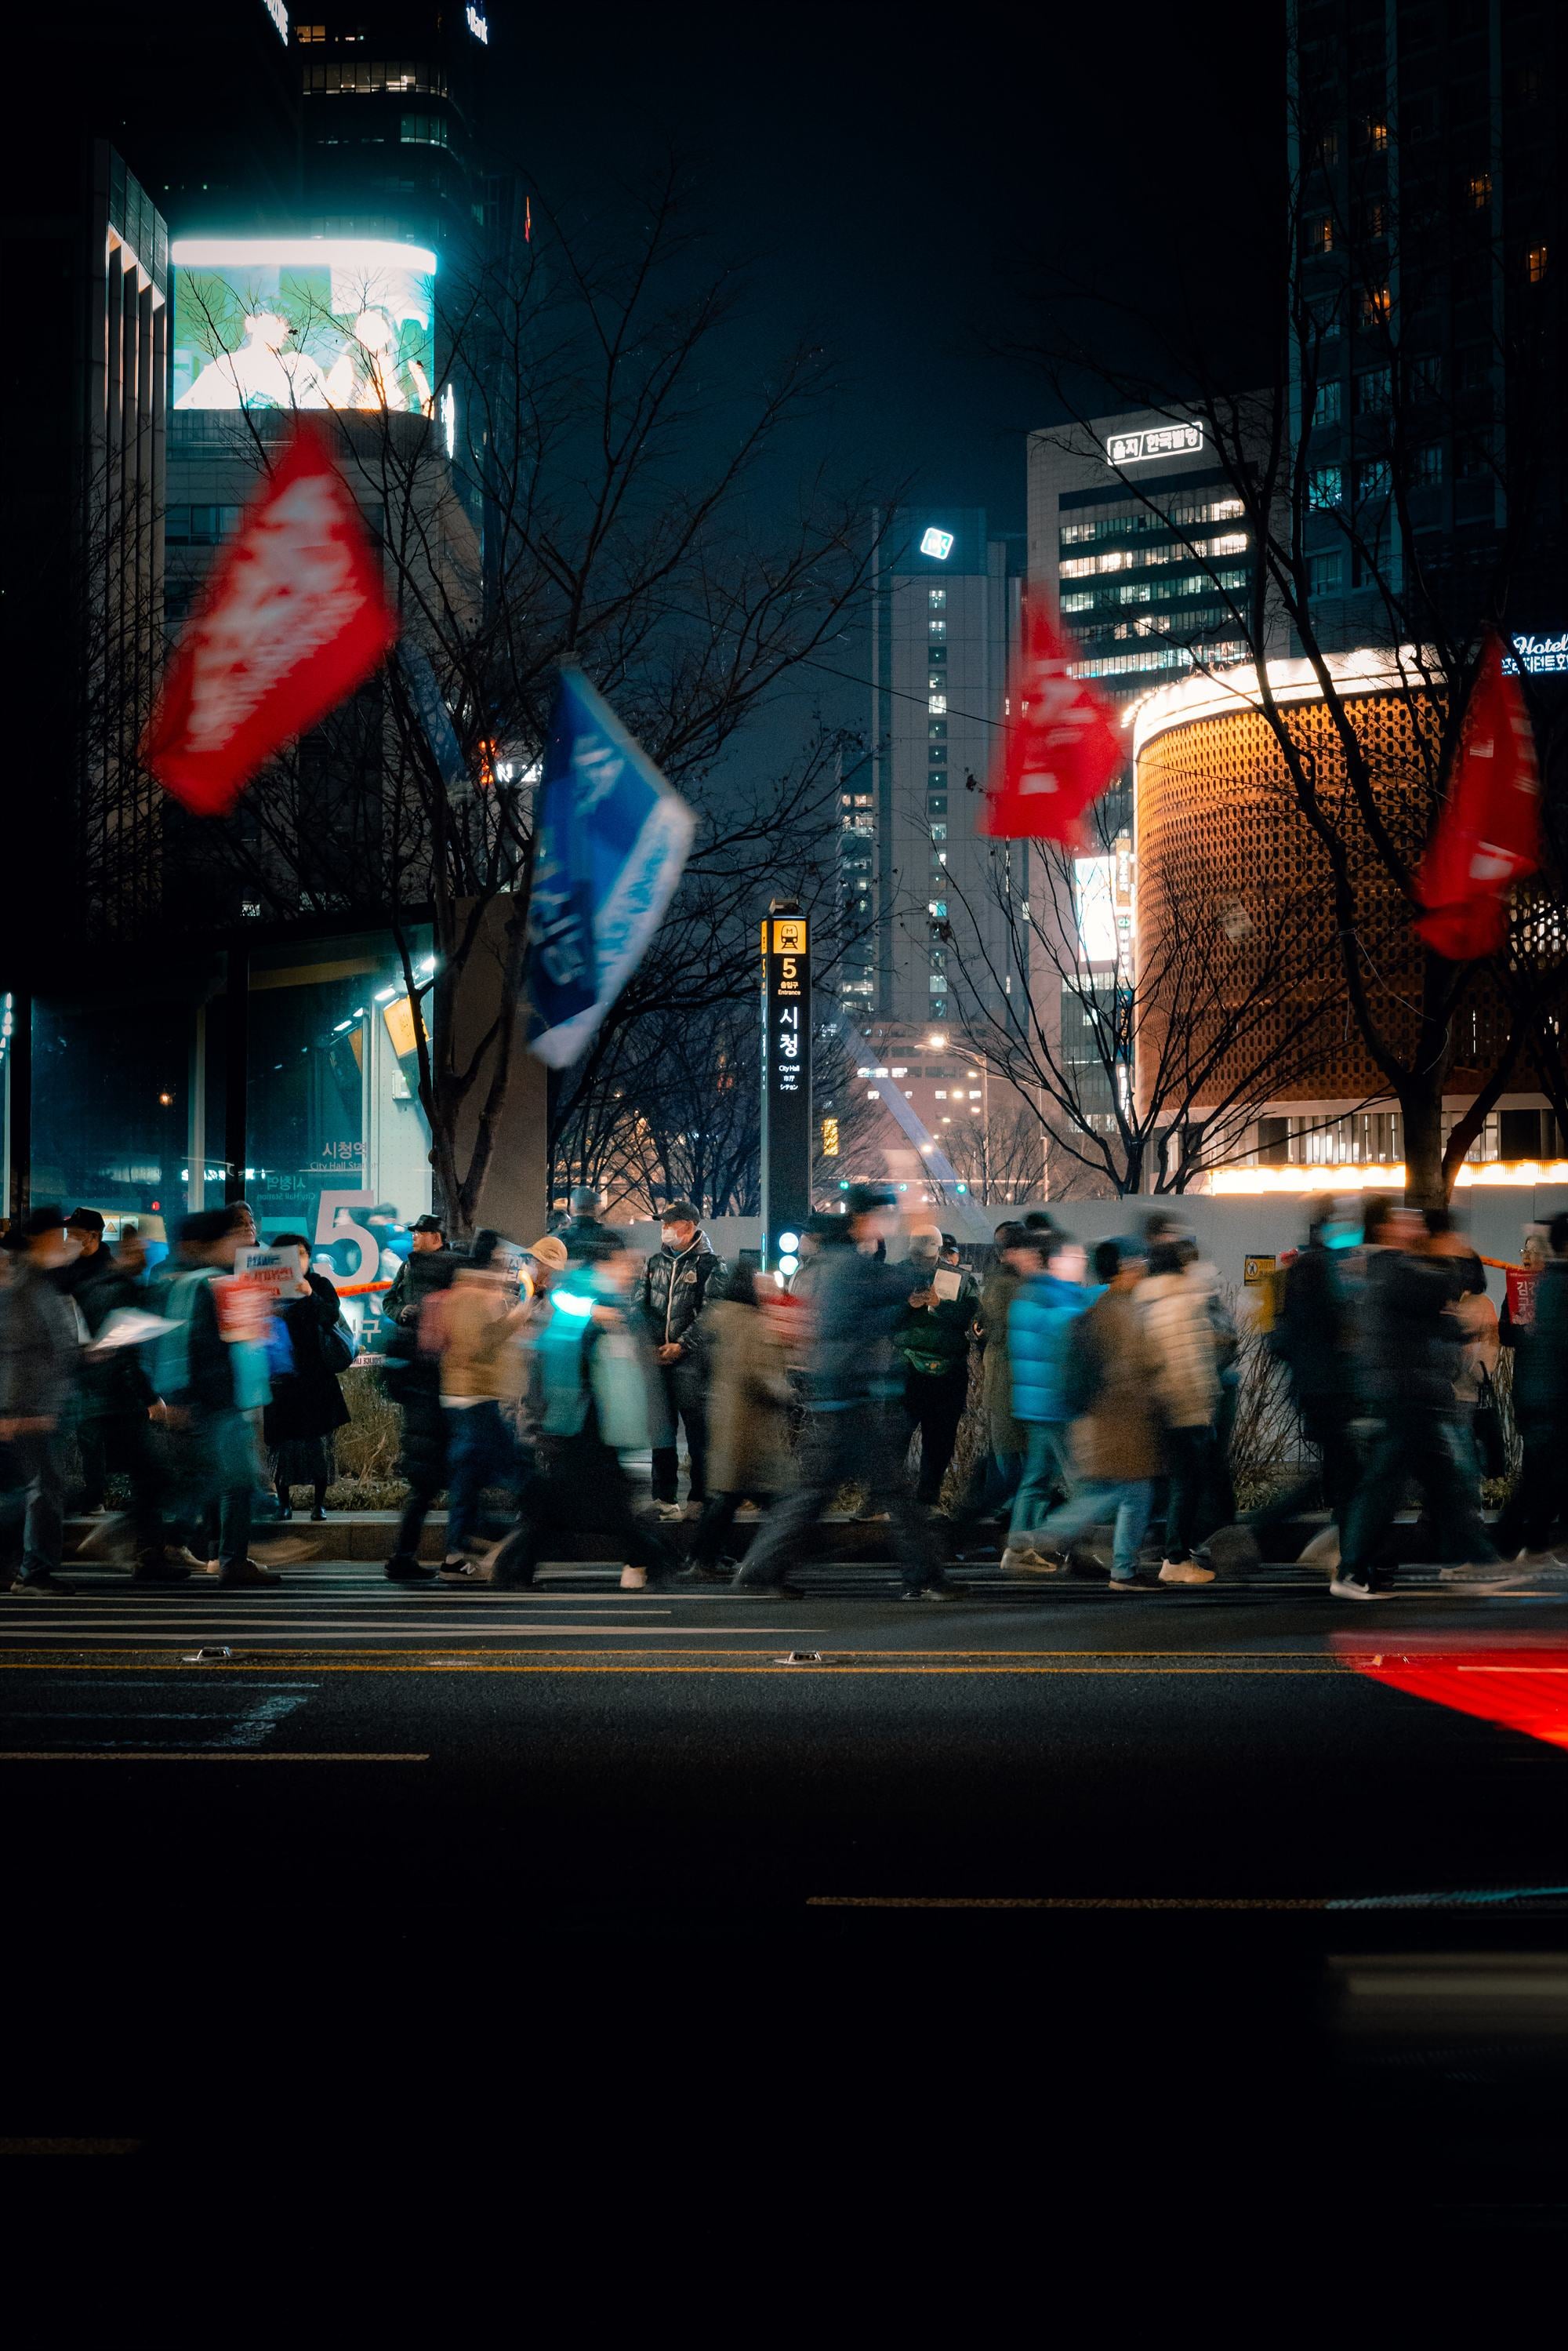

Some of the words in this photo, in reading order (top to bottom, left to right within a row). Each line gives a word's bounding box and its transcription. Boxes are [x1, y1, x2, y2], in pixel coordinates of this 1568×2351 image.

[1145, 427, 1198, 452] 한국빌딩
[1513, 634, 1568, 655] Hotel
[782, 957, 797, 979] 5
[779, 1006, 798, 1058] 시청
[322, 1141, 367, 1159] 시청역
[310, 1161, 327, 1172] City
[329, 1161, 346, 1171] Hall
[313, 1190, 379, 1289] 5
